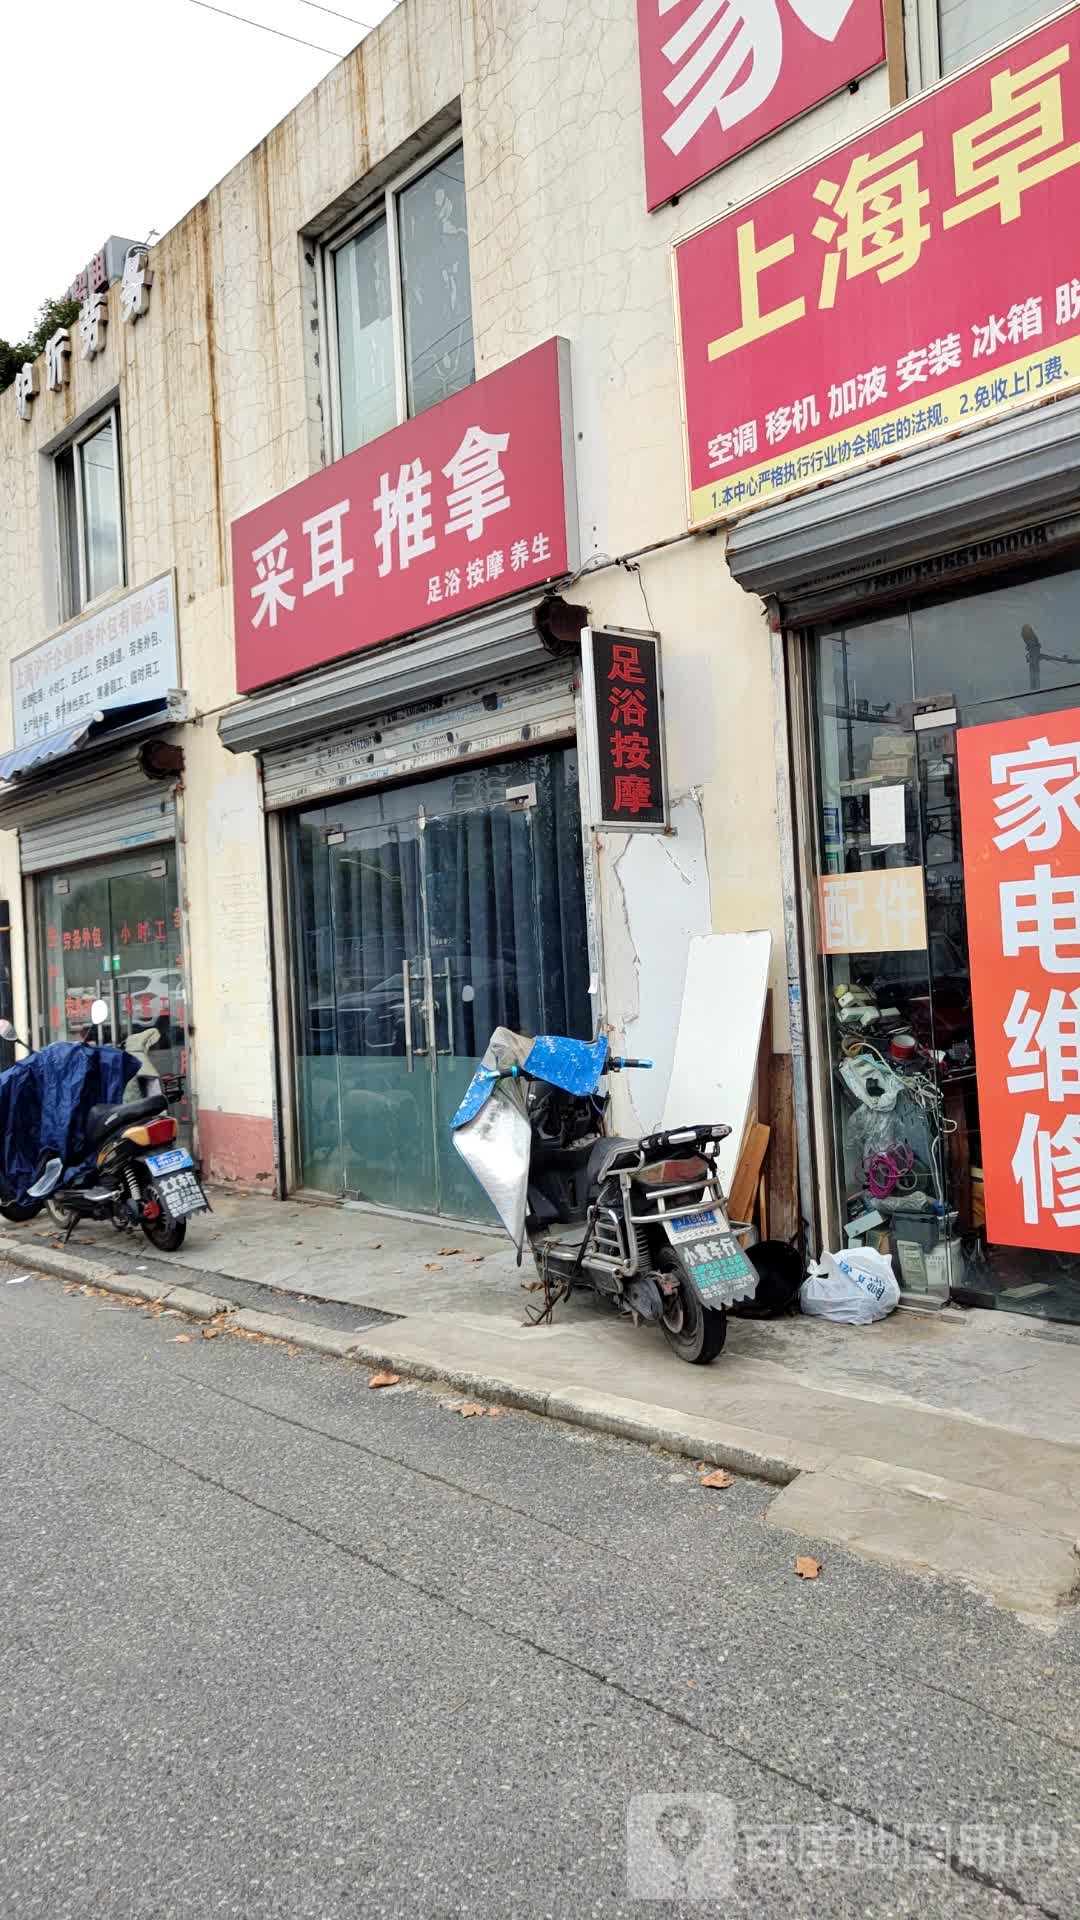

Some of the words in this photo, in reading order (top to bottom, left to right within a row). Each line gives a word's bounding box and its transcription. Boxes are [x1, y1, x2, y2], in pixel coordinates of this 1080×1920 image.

[708, 44, 1080, 362] 上海卓
[707, 421, 757, 469] 空调
[765, 394, 820, 445] 移机
[828, 365, 888, 419] 加液
[896, 333, 962, 392] 安装
[971, 296, 1043, 358] 冰箱
[711, 403, 949, 509] 1.本中心严格执行行业协会规定的法规。
[250, 498, 354, 629] 采耳
[373, 426, 511, 578] 推拿
[427, 568, 461, 605] 足浴
[466, 550, 504, 590] 按摩
[510, 532, 551, 573] 养生
[607, 644, 654, 814] 足浴按摩
[823, 873, 921, 949] 配件
